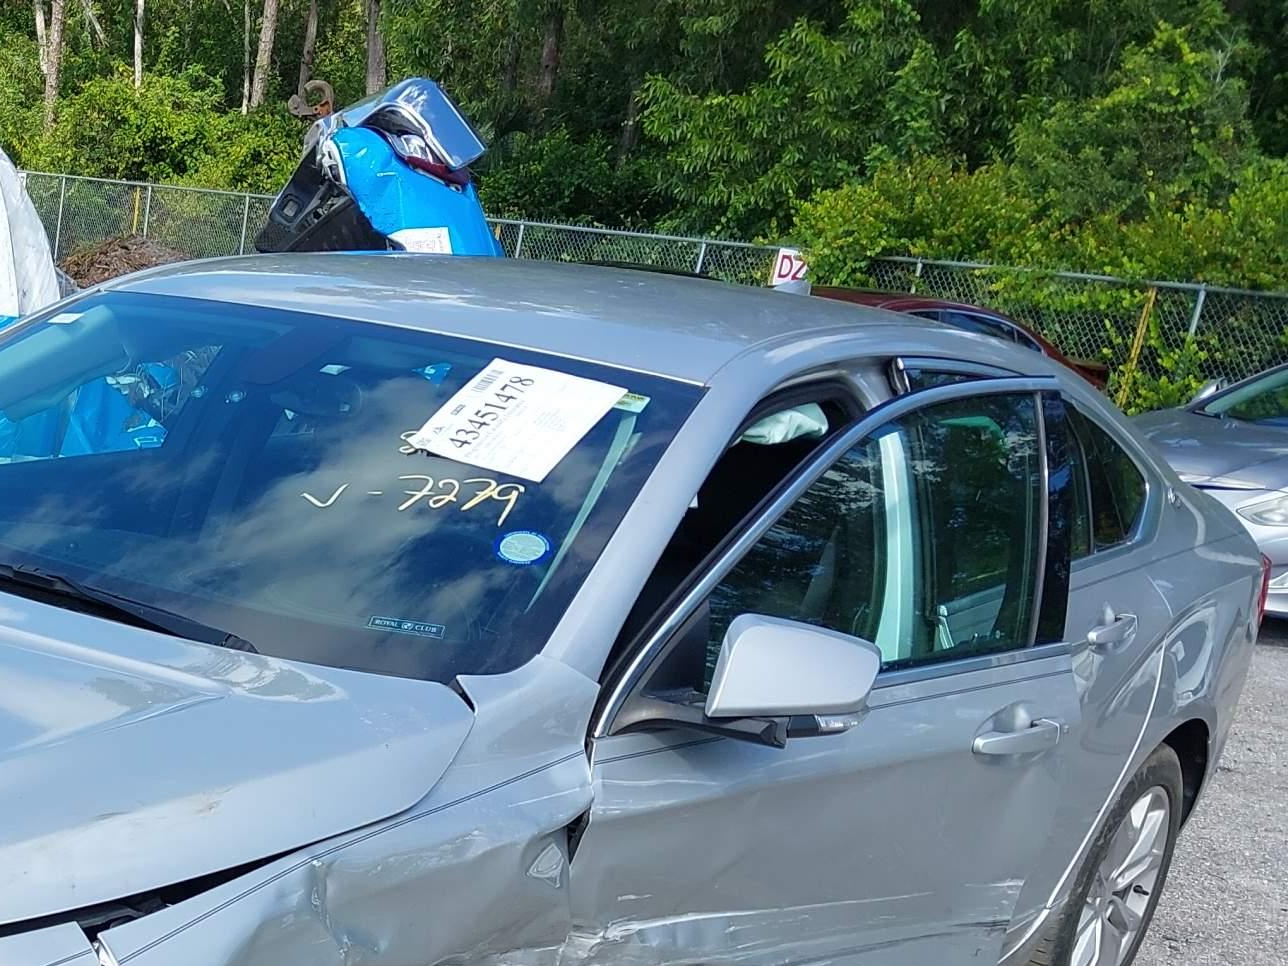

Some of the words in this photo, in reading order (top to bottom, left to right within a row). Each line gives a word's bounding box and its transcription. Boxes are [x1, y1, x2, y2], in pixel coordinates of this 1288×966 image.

[449, 376, 535, 449] 43451478
[397, 473, 525, 527] 7279
[415, 624, 437, 633] CLUB
